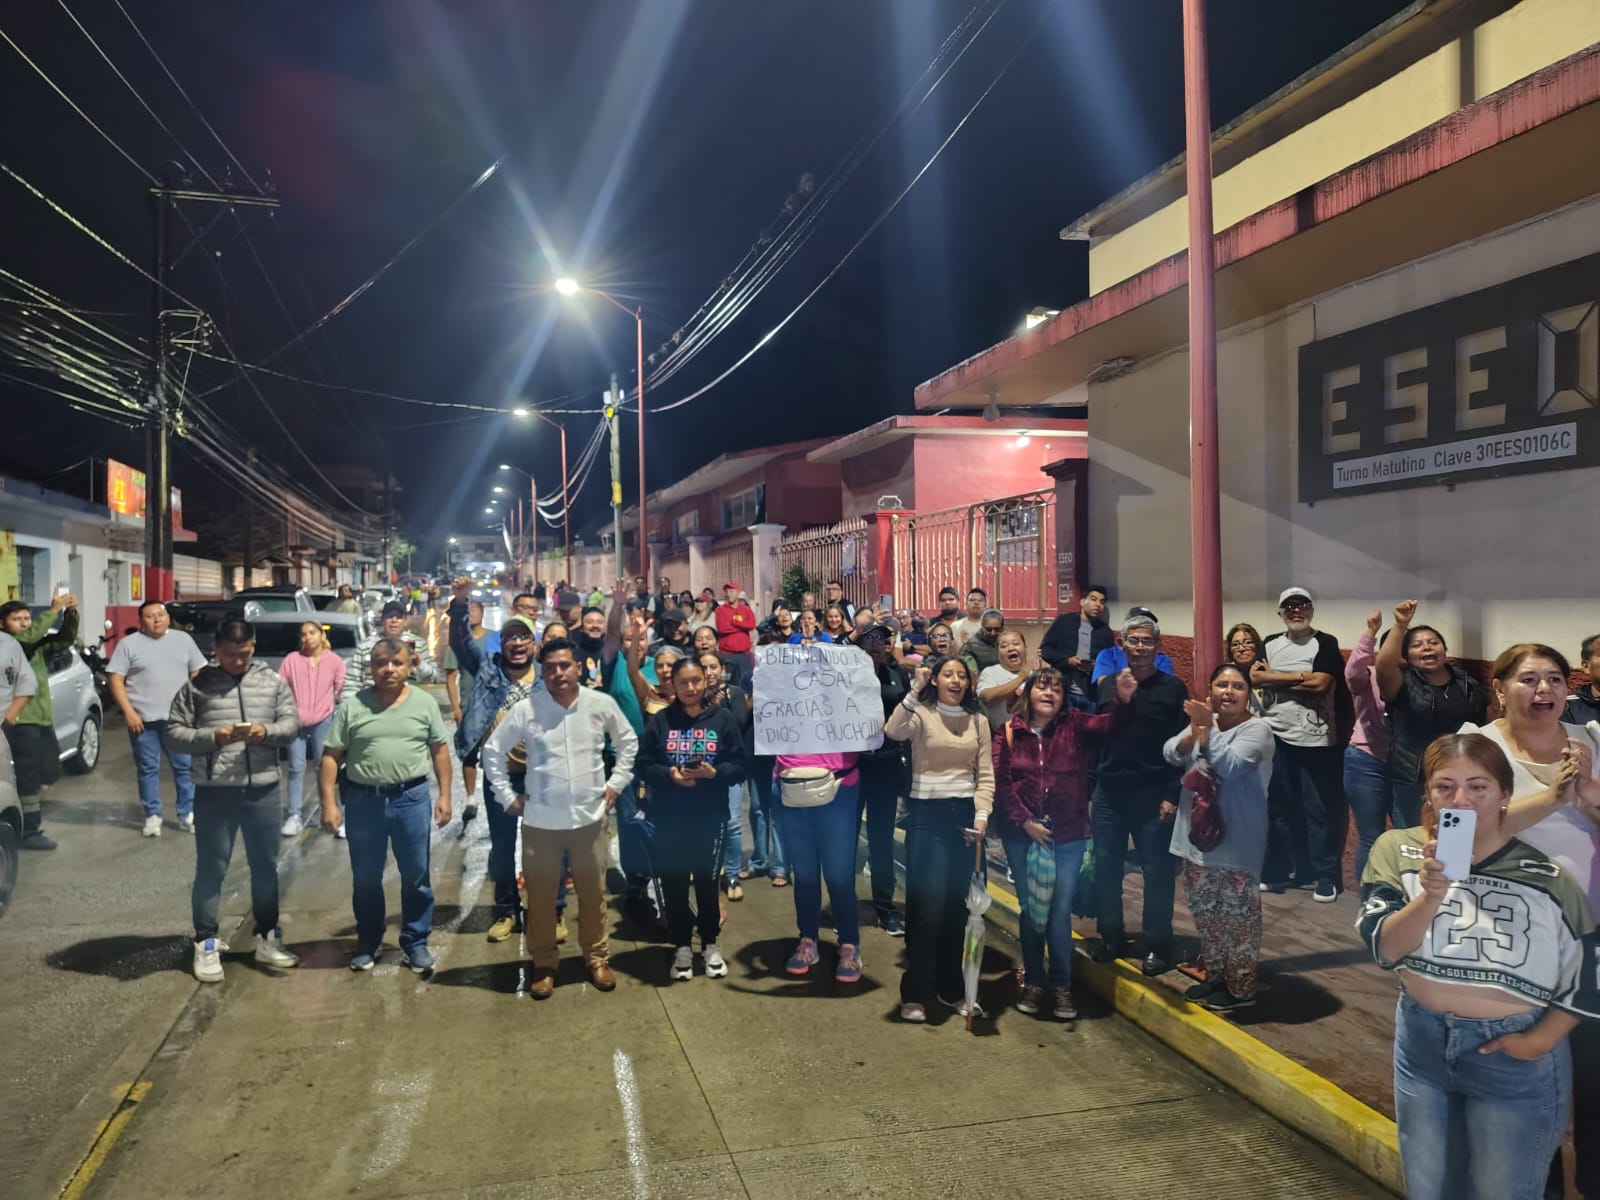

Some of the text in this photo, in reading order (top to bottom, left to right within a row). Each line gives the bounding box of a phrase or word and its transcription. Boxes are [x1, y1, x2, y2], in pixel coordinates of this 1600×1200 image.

[1337, 467, 1369, 482] Turno
[1373, 457, 1426, 477] Matutino
[1434, 450, 1472, 468] Clave
[845, 697, 860, 714] A
[1432, 886, 1531, 969] 23
